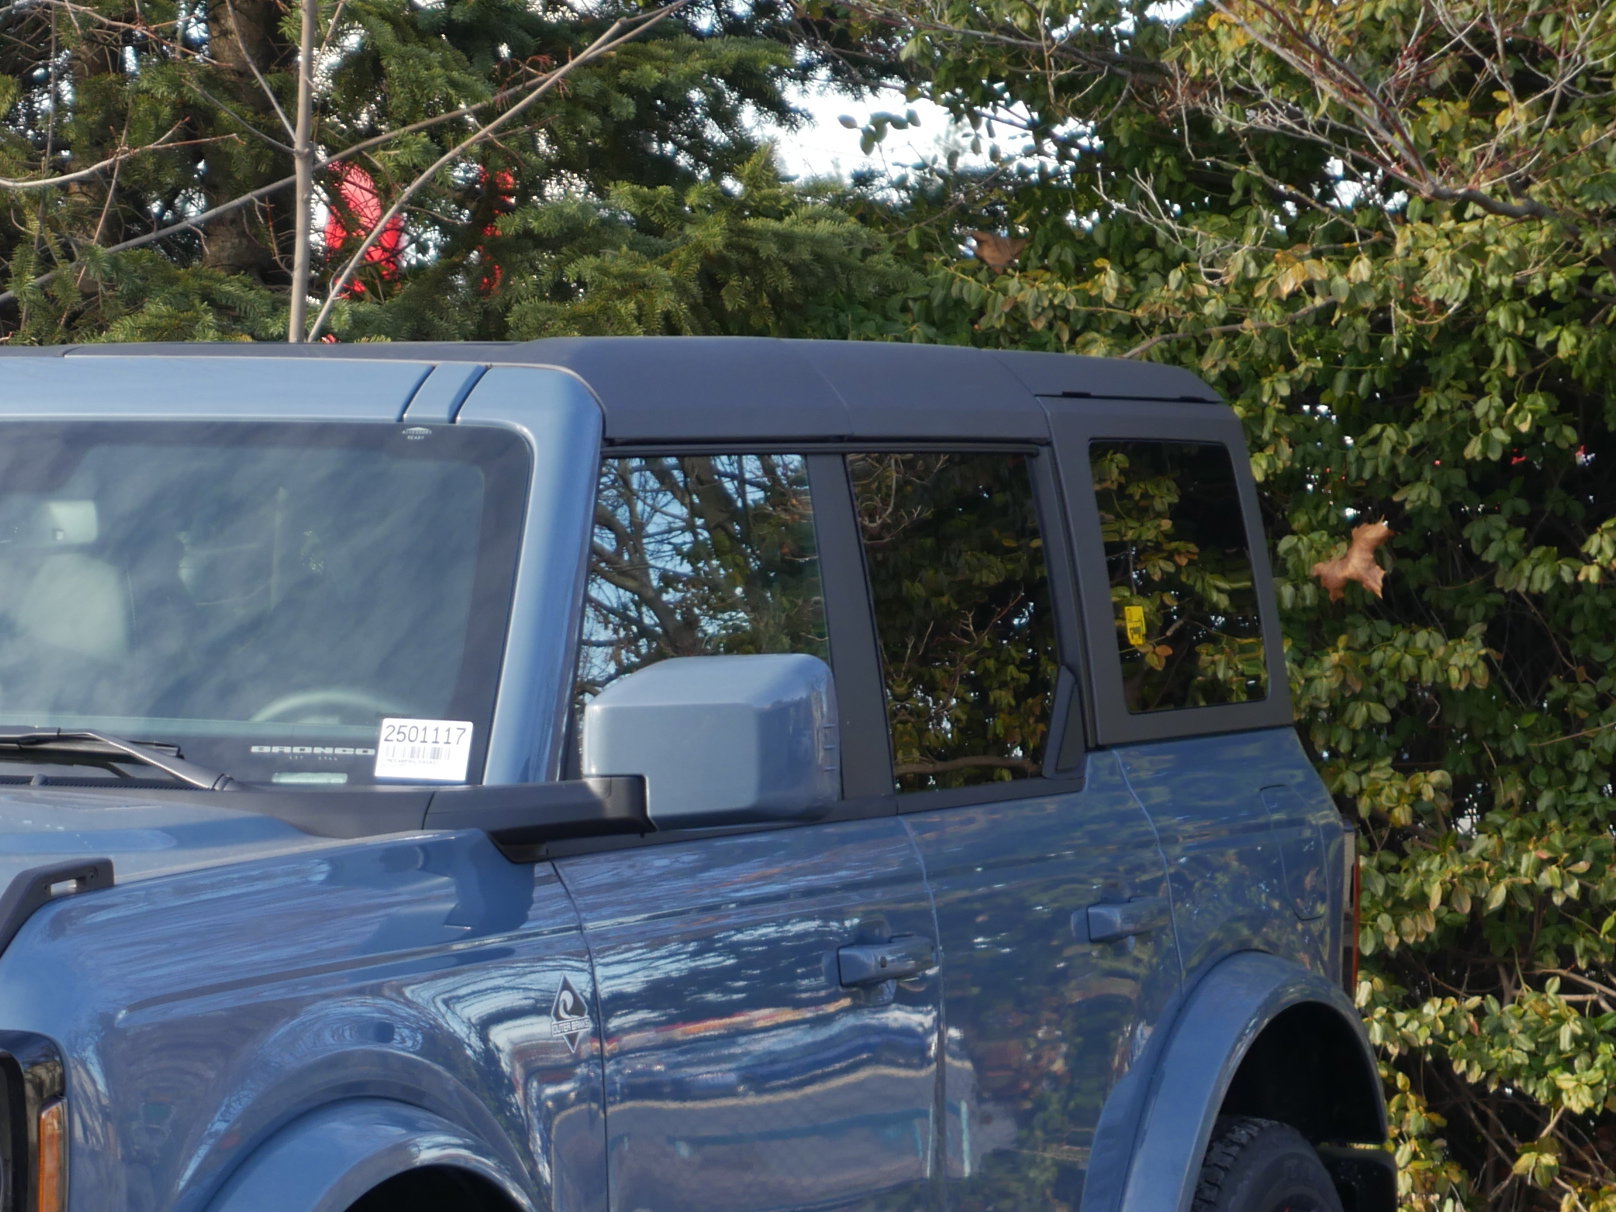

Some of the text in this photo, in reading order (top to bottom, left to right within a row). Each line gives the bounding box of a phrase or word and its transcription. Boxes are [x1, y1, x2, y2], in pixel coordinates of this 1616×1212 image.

[383, 725, 467, 745] 2501117
[250, 745, 376, 756] BRONCO
[553, 1021, 571, 1034] OUTER
